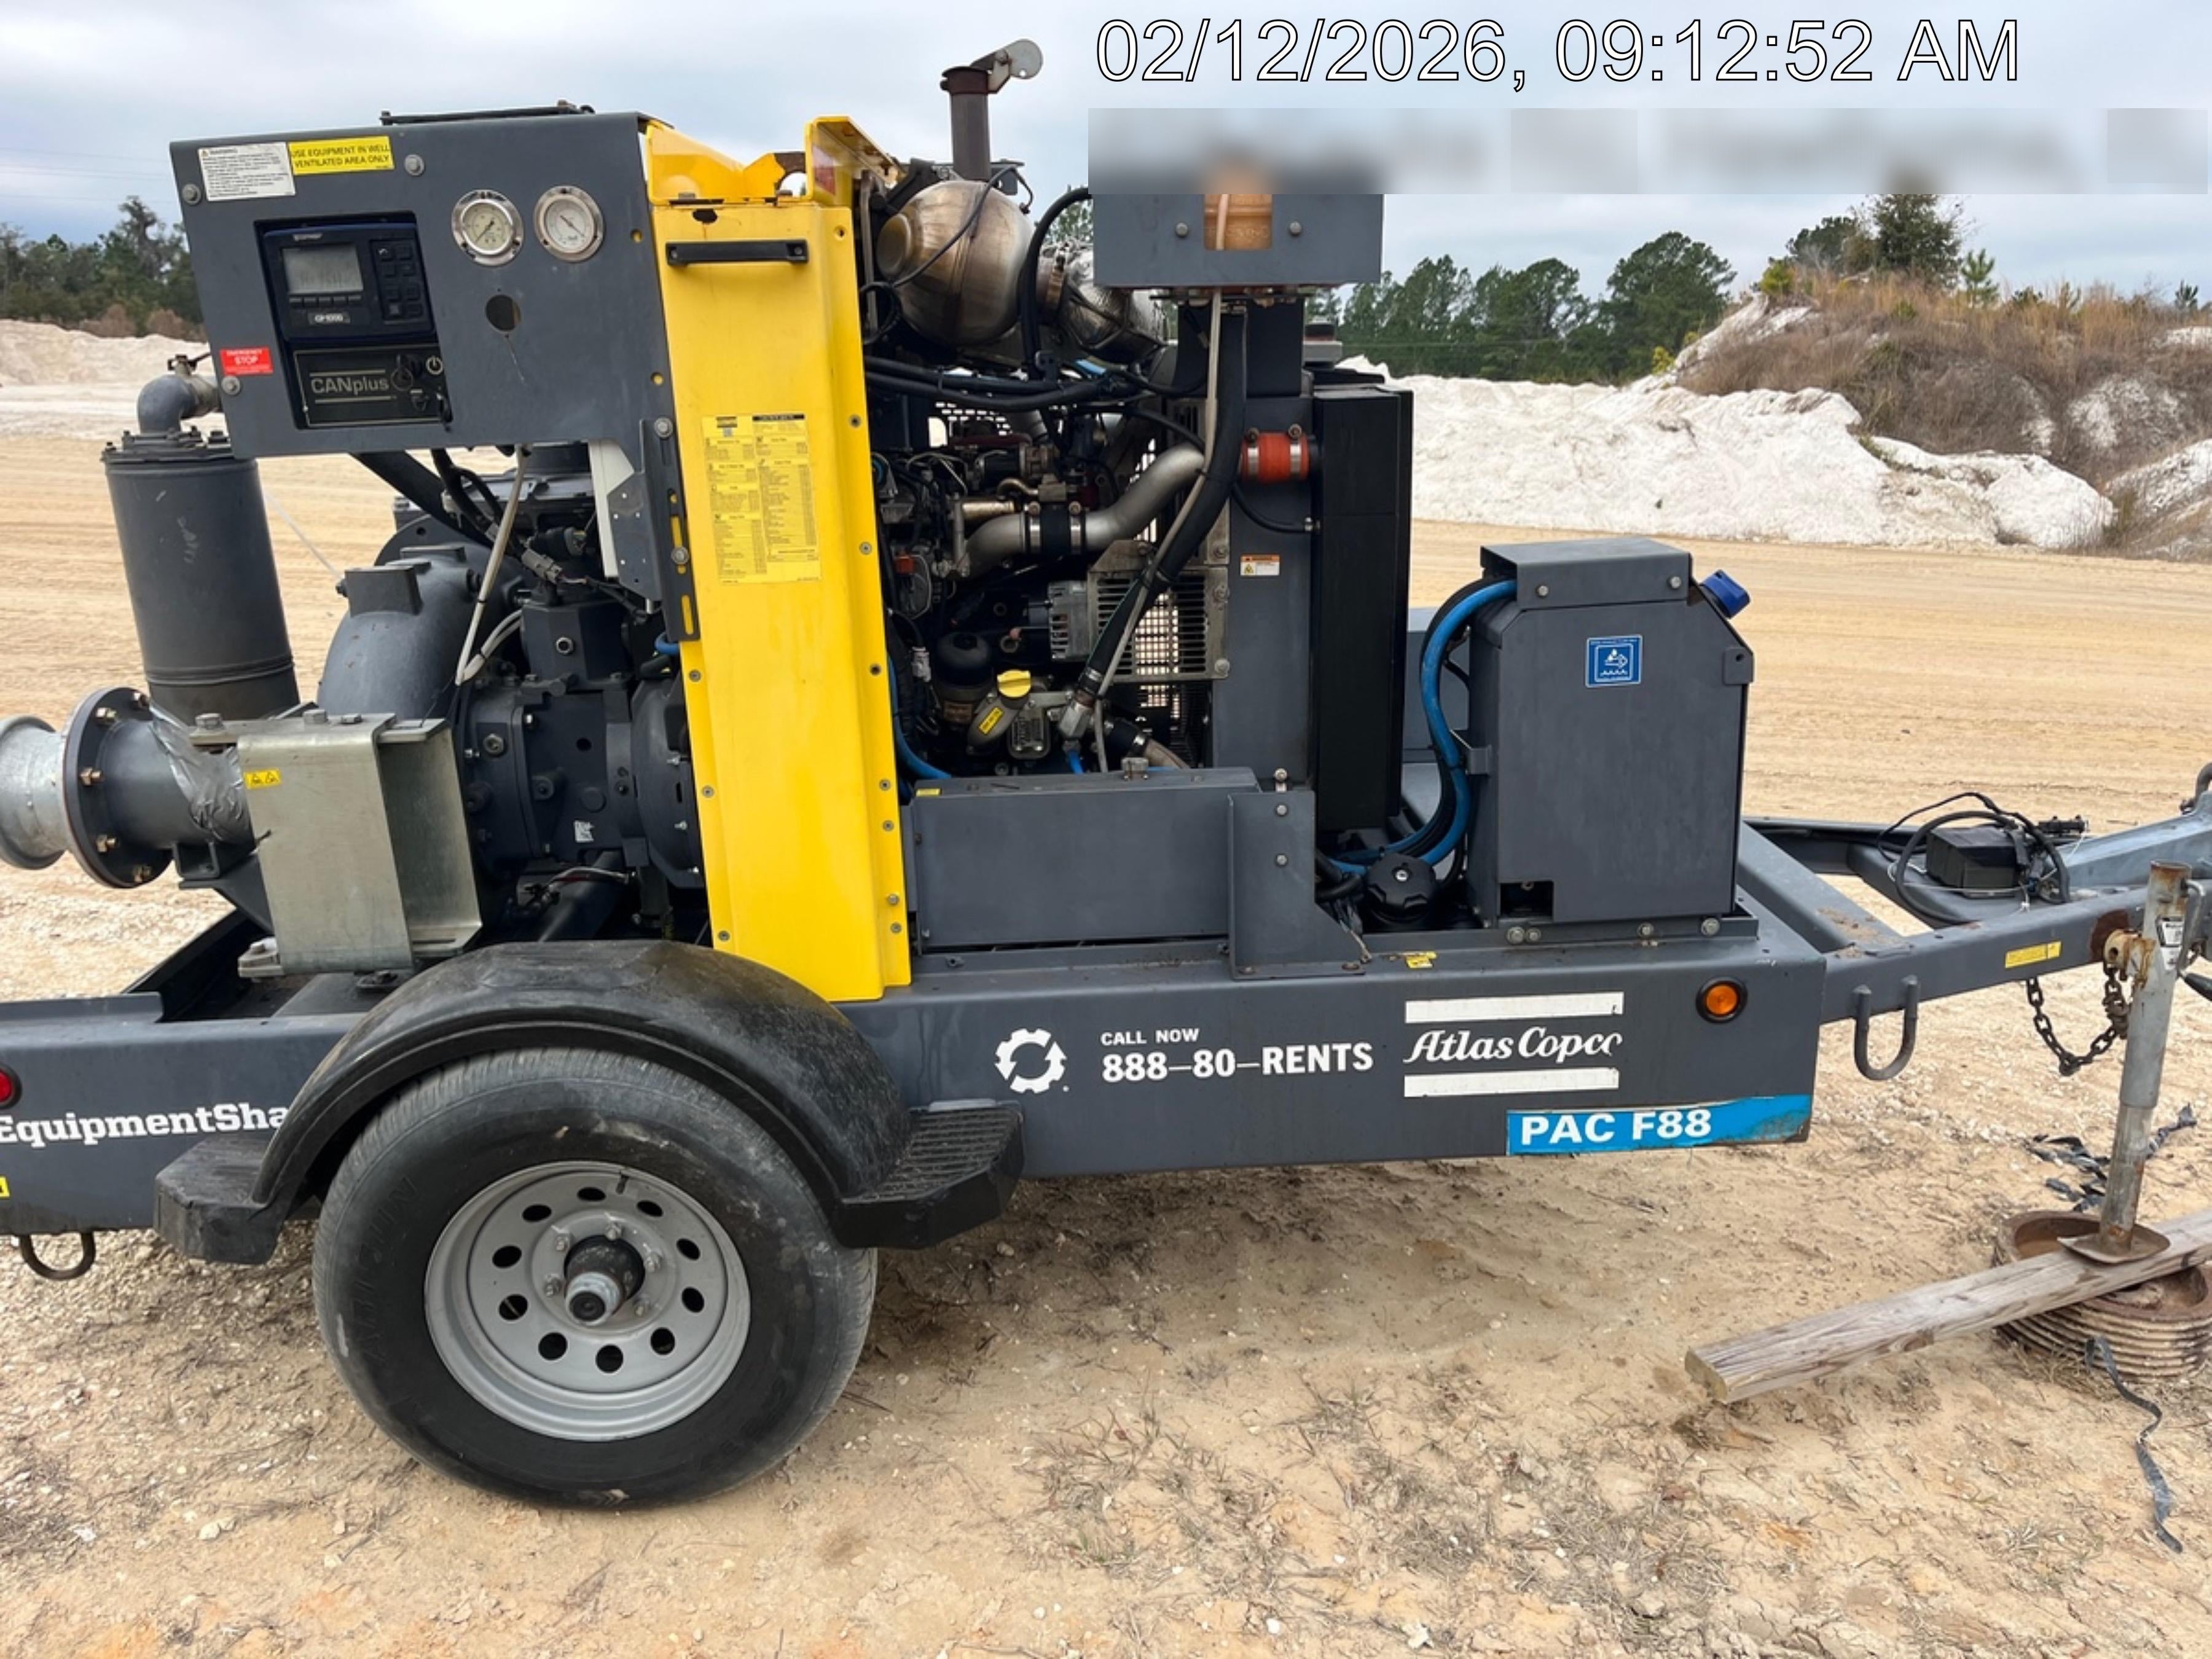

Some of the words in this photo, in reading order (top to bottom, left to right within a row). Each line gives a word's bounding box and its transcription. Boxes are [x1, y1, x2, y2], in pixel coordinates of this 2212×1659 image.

[308, 146, 355, 156] EQUIPMENT
[294, 157, 343, 168] VENTILATED
[344, 156, 366, 165] AREA
[368, 154, 389, 163] ONLY
[235, 356, 258, 365] STOP
[311, 375, 389, 394] CANplus
[1100, 1031, 1147, 1046] CALL
[1156, 1028, 1199, 1043] NOW
[1403, 1029, 1513, 1063] Atlas
[1521, 1112, 1615, 1145] PAC
[1632, 1109, 1712, 1141] F88
